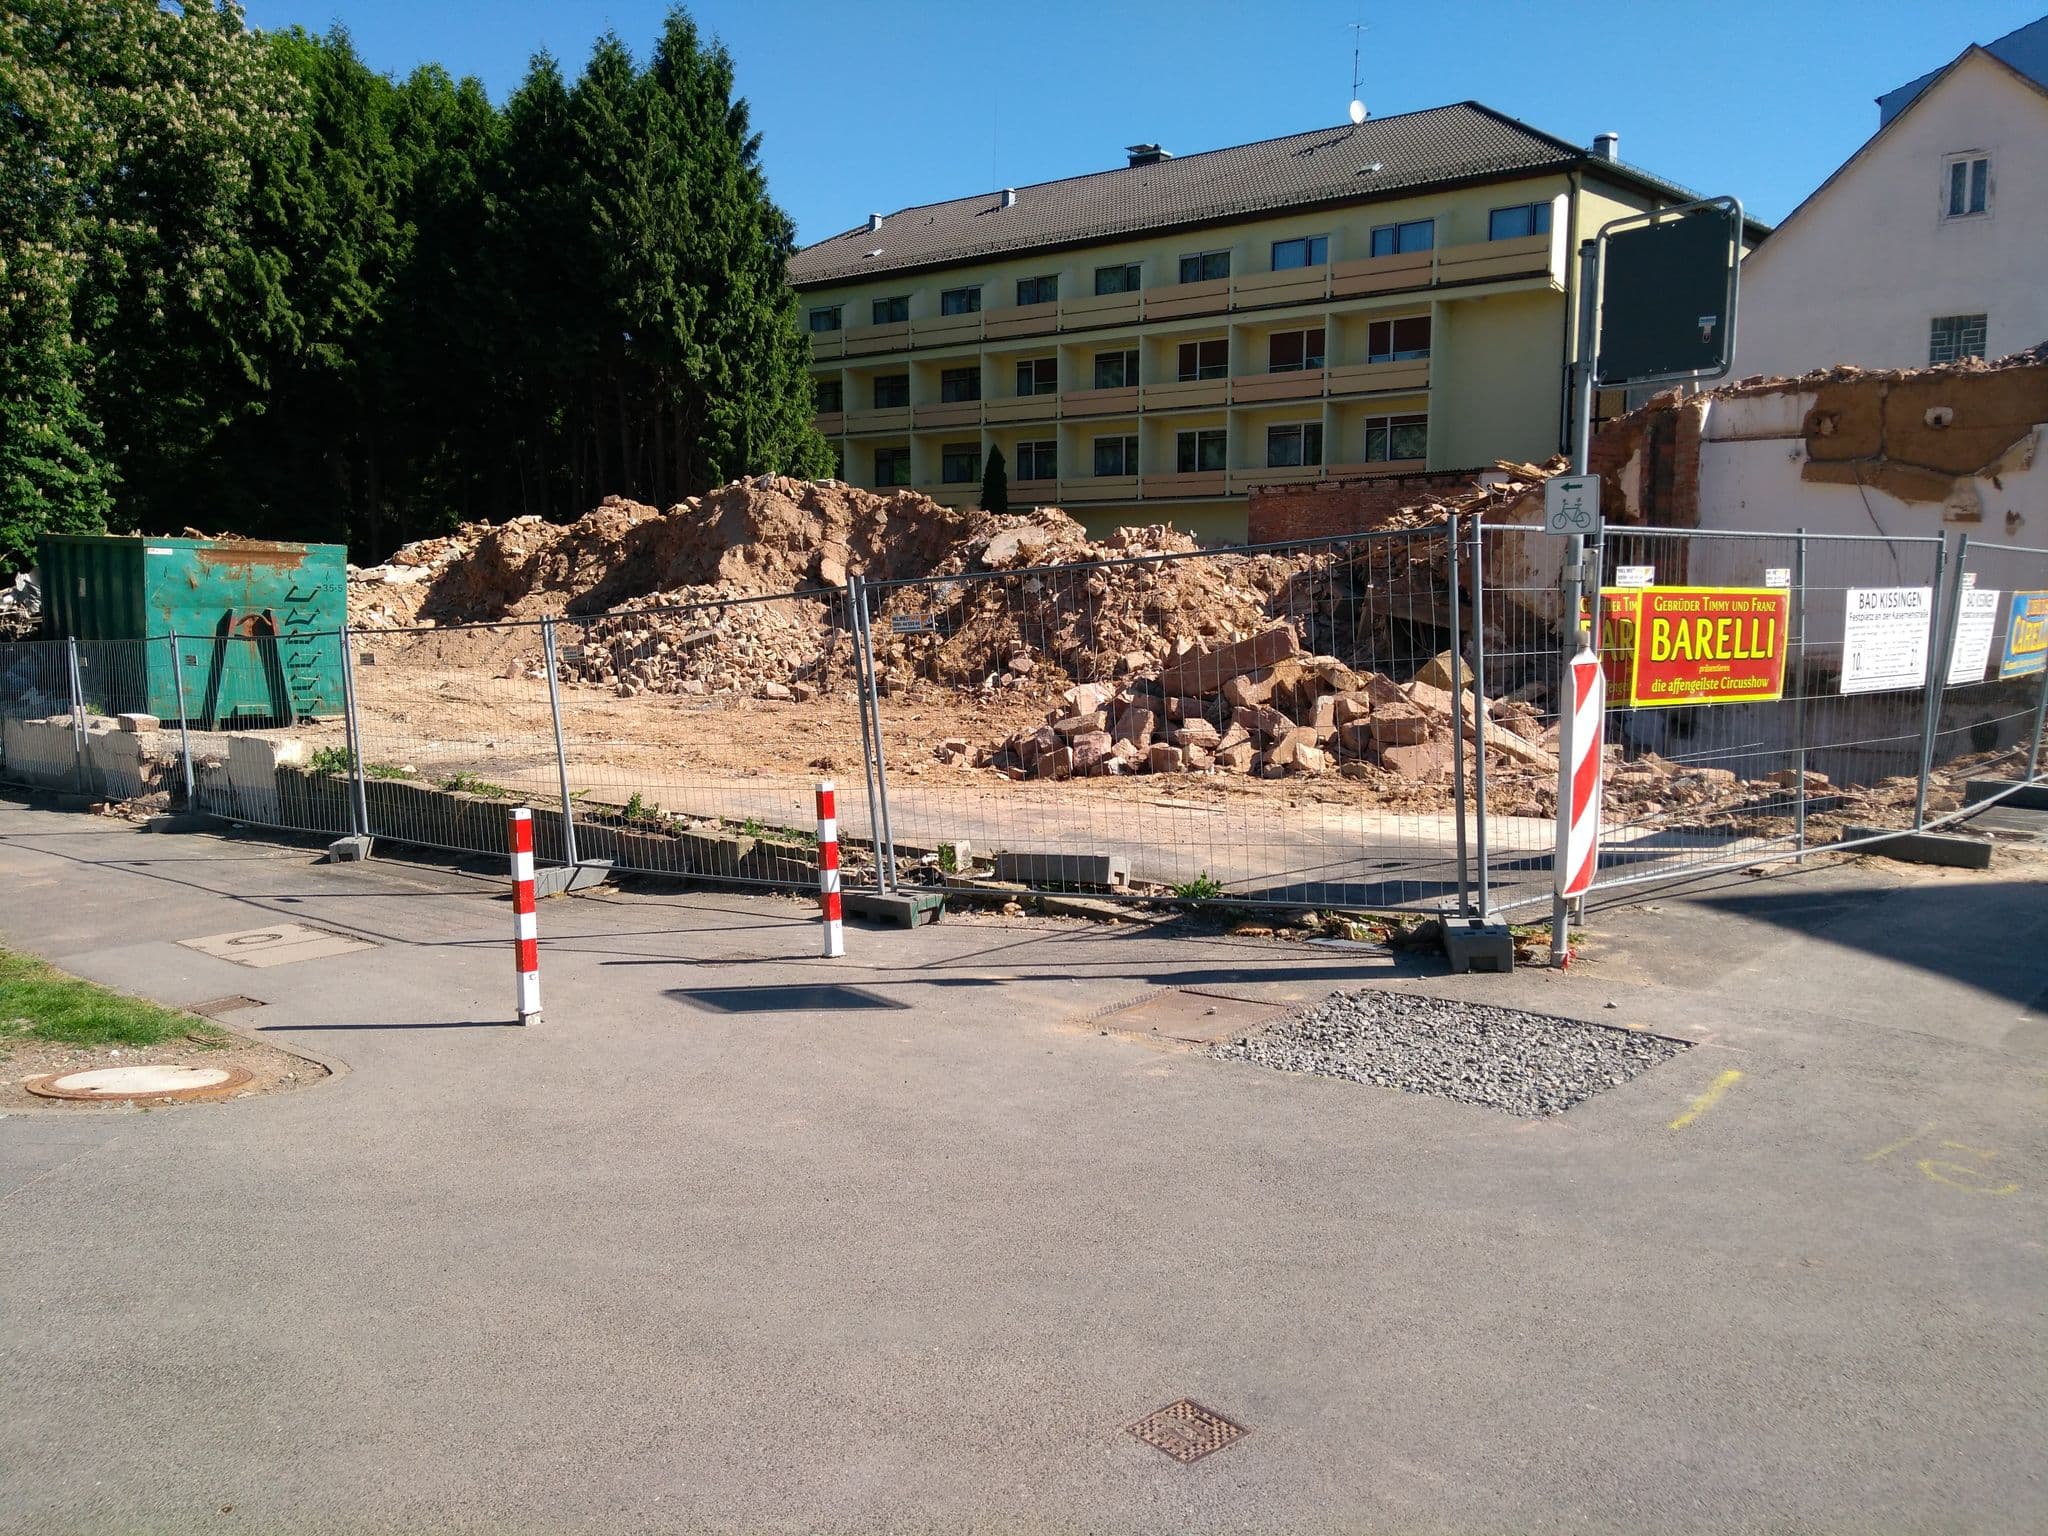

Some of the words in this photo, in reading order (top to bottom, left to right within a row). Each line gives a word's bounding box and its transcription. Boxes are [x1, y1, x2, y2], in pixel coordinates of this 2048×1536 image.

[1654, 596, 1700, 612] GEBRÜDER
[1702, 596, 1730, 612] TIMMY
[1732, 600, 1749, 612] UND
[1751, 597, 1776, 612] FRANZ
[1859, 593, 1878, 609] BAD
[1880, 591, 1922, 609] KISSINGEN
[1650, 617, 1776, 662] BARELLI
[1652, 678, 1667, 692] die
[1667, 677, 1719, 695] affengeilste
[1720, 675, 1770, 689] Circusshow
